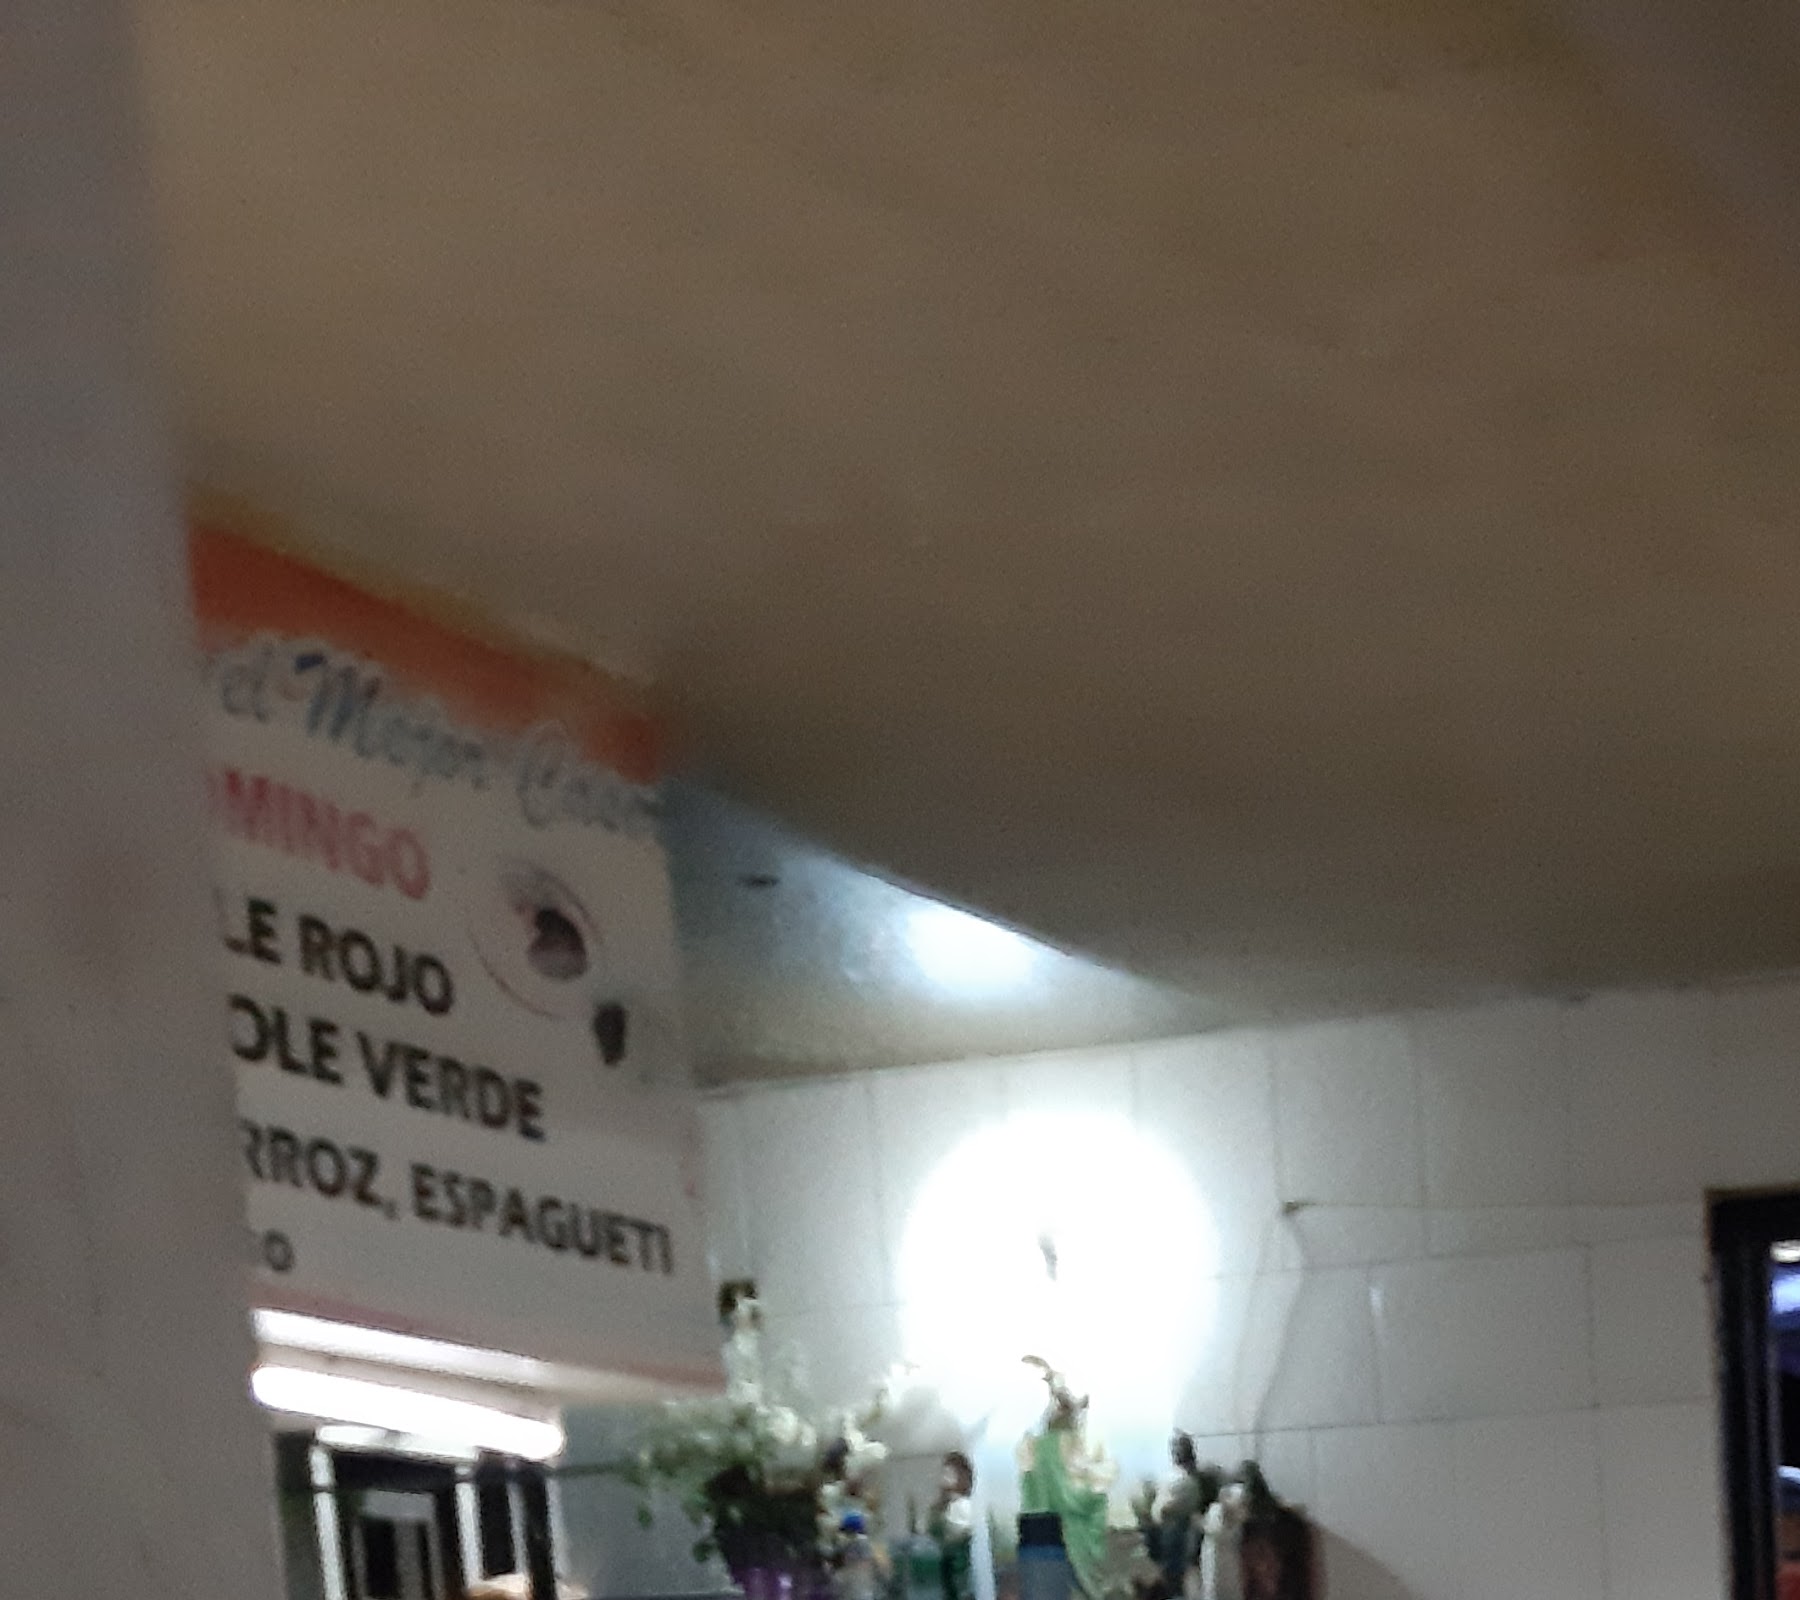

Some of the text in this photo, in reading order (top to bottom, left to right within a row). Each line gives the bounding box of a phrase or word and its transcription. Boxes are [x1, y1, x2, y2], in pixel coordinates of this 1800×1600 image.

[298, 911, 454, 1017] ROJO
[355, 1029, 546, 1143] VERDE
[411, 1159, 675, 1277] ESPAGUETI
